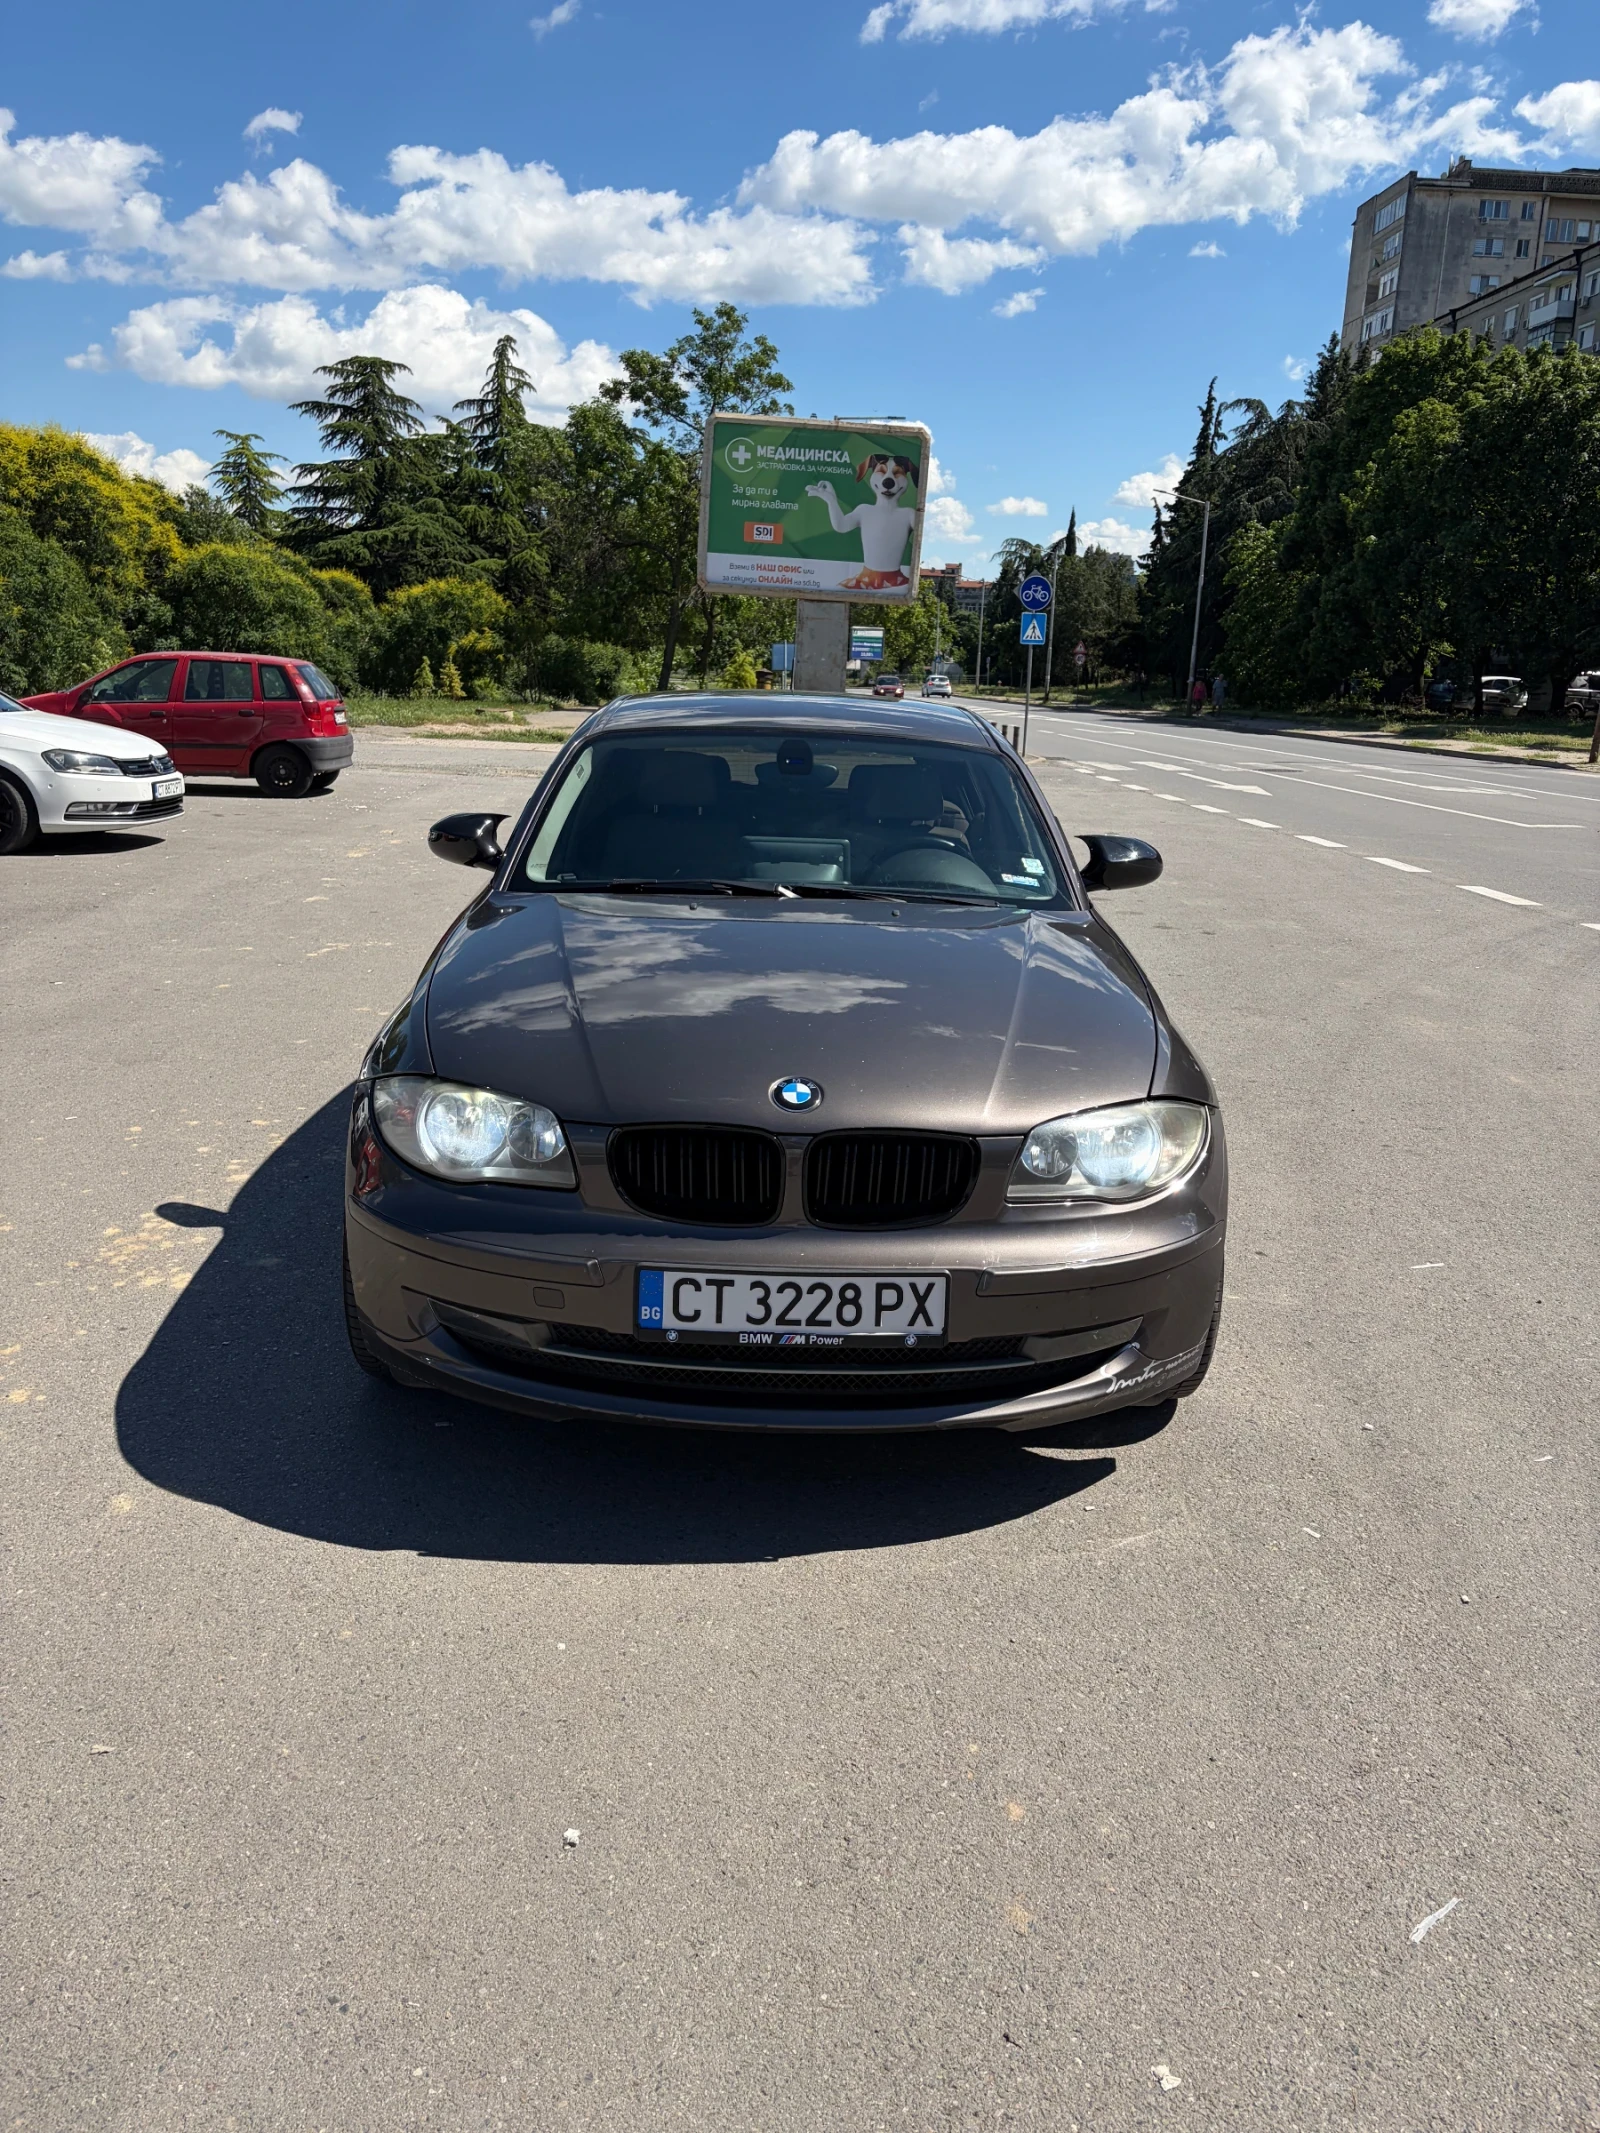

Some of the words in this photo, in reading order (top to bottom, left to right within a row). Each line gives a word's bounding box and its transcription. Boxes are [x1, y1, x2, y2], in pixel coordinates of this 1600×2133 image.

[756, 445, 851, 463] МЕДИЦИНСКА
[756, 461, 806, 472] ЗАСТРАХОВКА
[817, 466, 853, 475] ЧУЖБИНА
[732, 484, 743, 493] За
[745, 486, 756, 495] да
[757, 487, 770, 496] ти
[731, 499, 760, 509] мирна
[761, 500, 799, 510] главата
[755, 526, 773, 537] SDI
[756, 563, 776, 572] НАШ
[777, 565, 802, 574] ОФИС
[758, 574, 793, 585] ОНЛАЙН
[802, 579, 821, 588] sdi.bg
[672, 1277, 735, 1324] CT
[745, 1280, 863, 1327] 3228
[874, 1281, 936, 1327] PX
[641, 1305, 661, 1320] BG
[739, 1333, 773, 1344] BMW
[809, 1334, 844, 1345] Power
